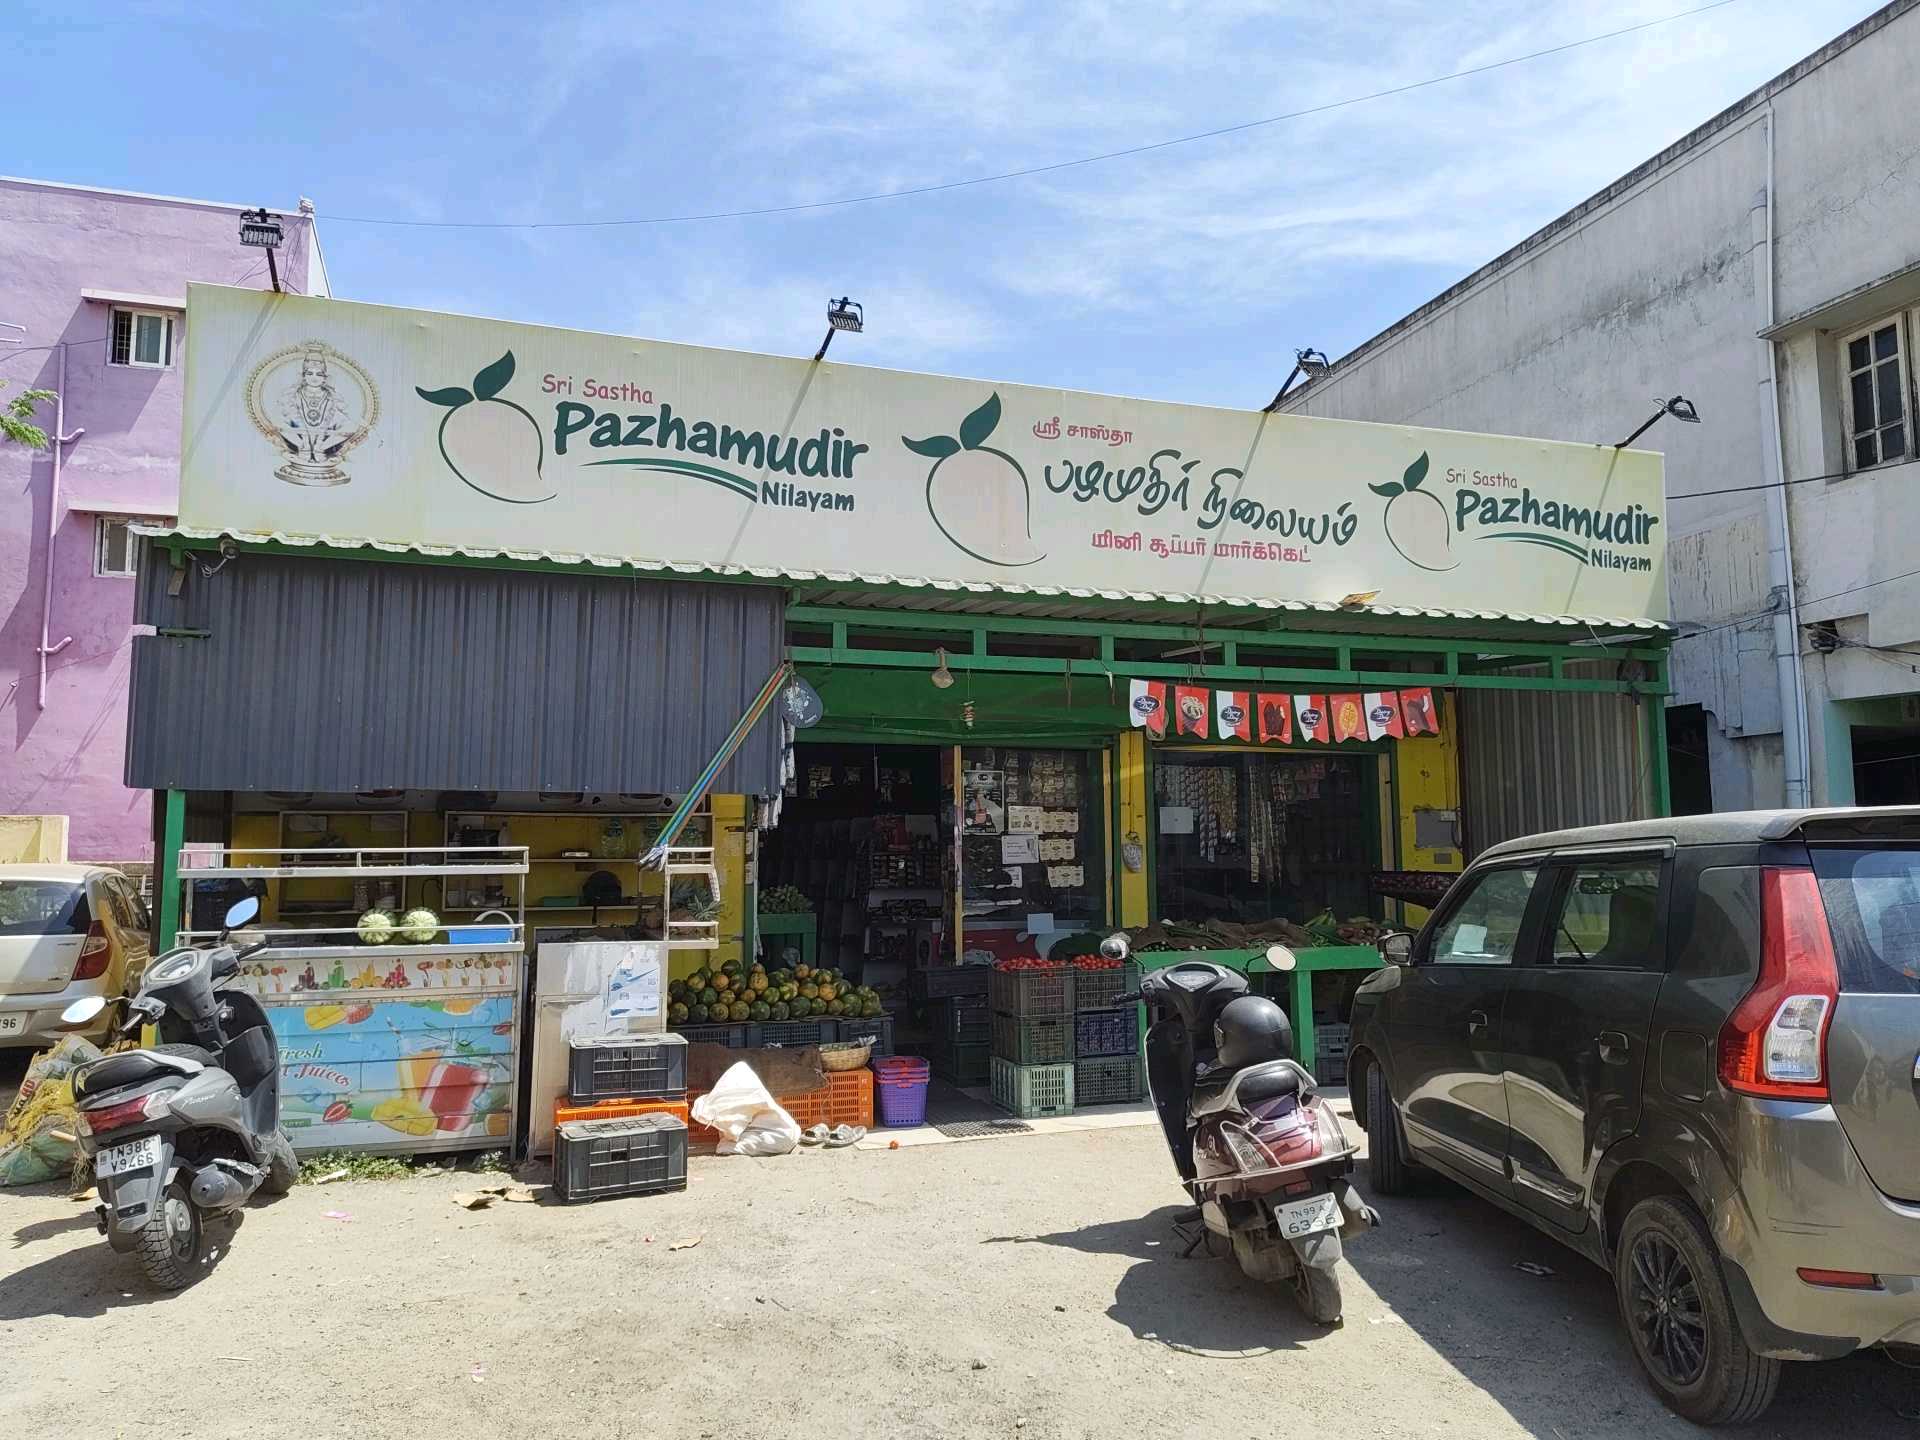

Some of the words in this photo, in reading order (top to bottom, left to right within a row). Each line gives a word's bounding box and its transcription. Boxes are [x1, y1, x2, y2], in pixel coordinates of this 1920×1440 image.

[542, 374, 573, 395] Sri
[583, 379, 653, 404] Sastha
[554, 401, 870, 478] Pazhamudir
[1067, 424, 1133, 446] சாஸ்தா
[1446, 468, 1466, 484] Sri
[1472, 471, 1518, 489] Sastha
[762, 481, 855, 512] Nilayam
[1044, 449, 1201, 516] பழமுதிர்
[1197, 468, 1358, 546] நிலையம்
[1456, 488, 1659, 545] Pazhamudir
[1092, 529, 1142, 551] மினி
[1149, 534, 1207, 559] சூப்பர்
[1213, 538, 1312, 563] மார்க்கெட்
[1591, 549, 1652, 573] Nilayam
[0, 1018, 17, 1029] 96
